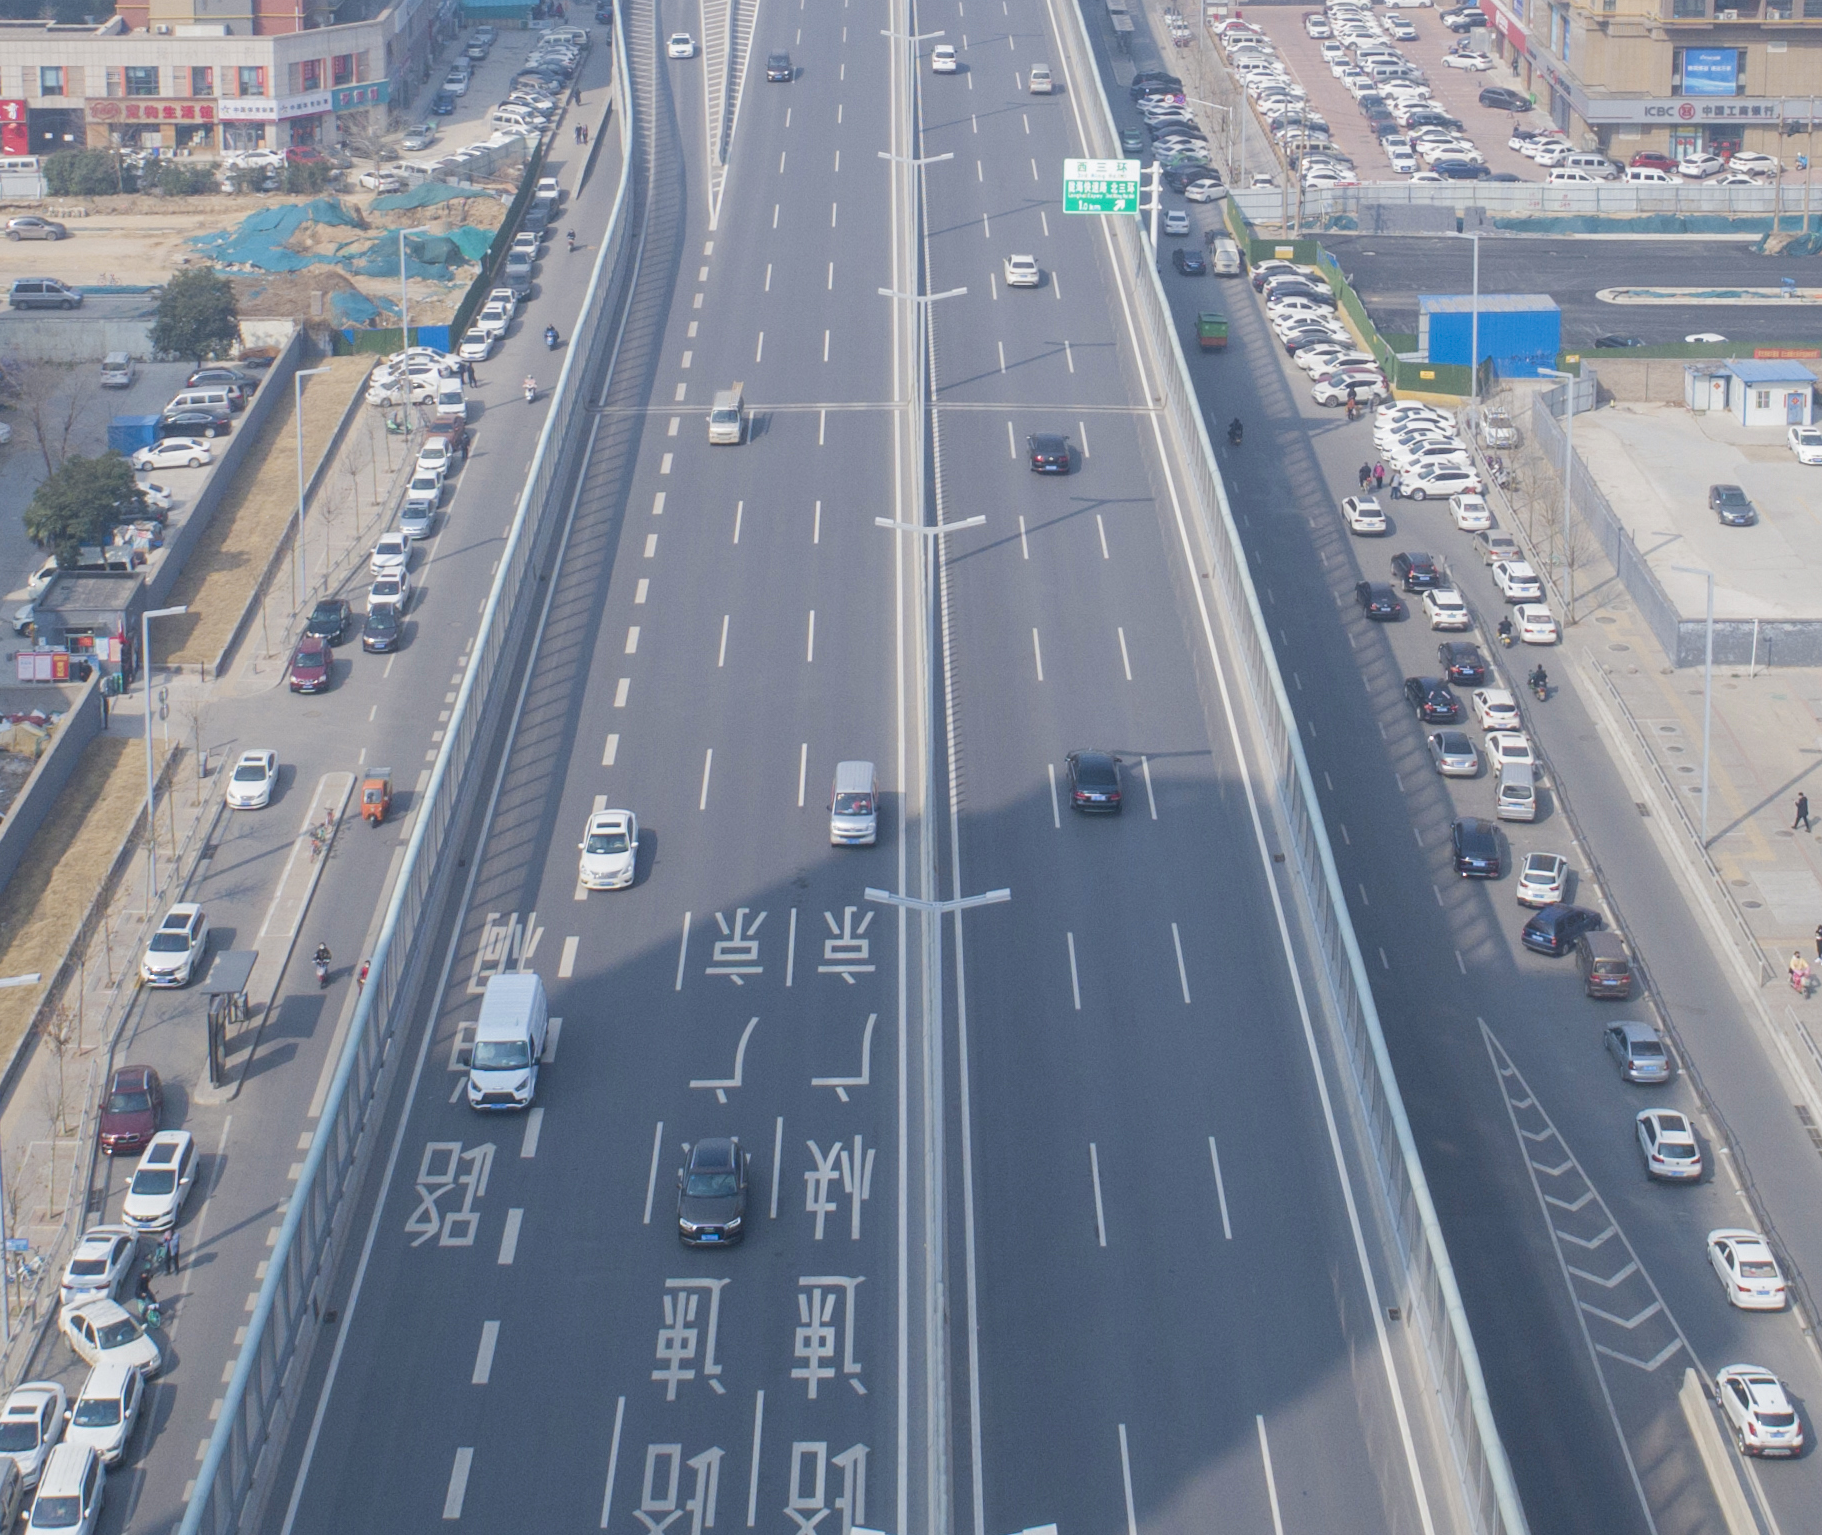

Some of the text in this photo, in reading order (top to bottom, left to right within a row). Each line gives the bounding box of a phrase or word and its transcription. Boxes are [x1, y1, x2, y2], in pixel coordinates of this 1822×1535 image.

[1644, 106, 1674, 117] ICBC
[1702, 104, 1775, 117] 中国工商银行
[1077, 161, 1127, 172] 西三环
[1111, 181, 1135, 193] 北三环
[632, 907, 767, 1535] 京广速路
[784, 905, 877, 1535] 京广快速路
